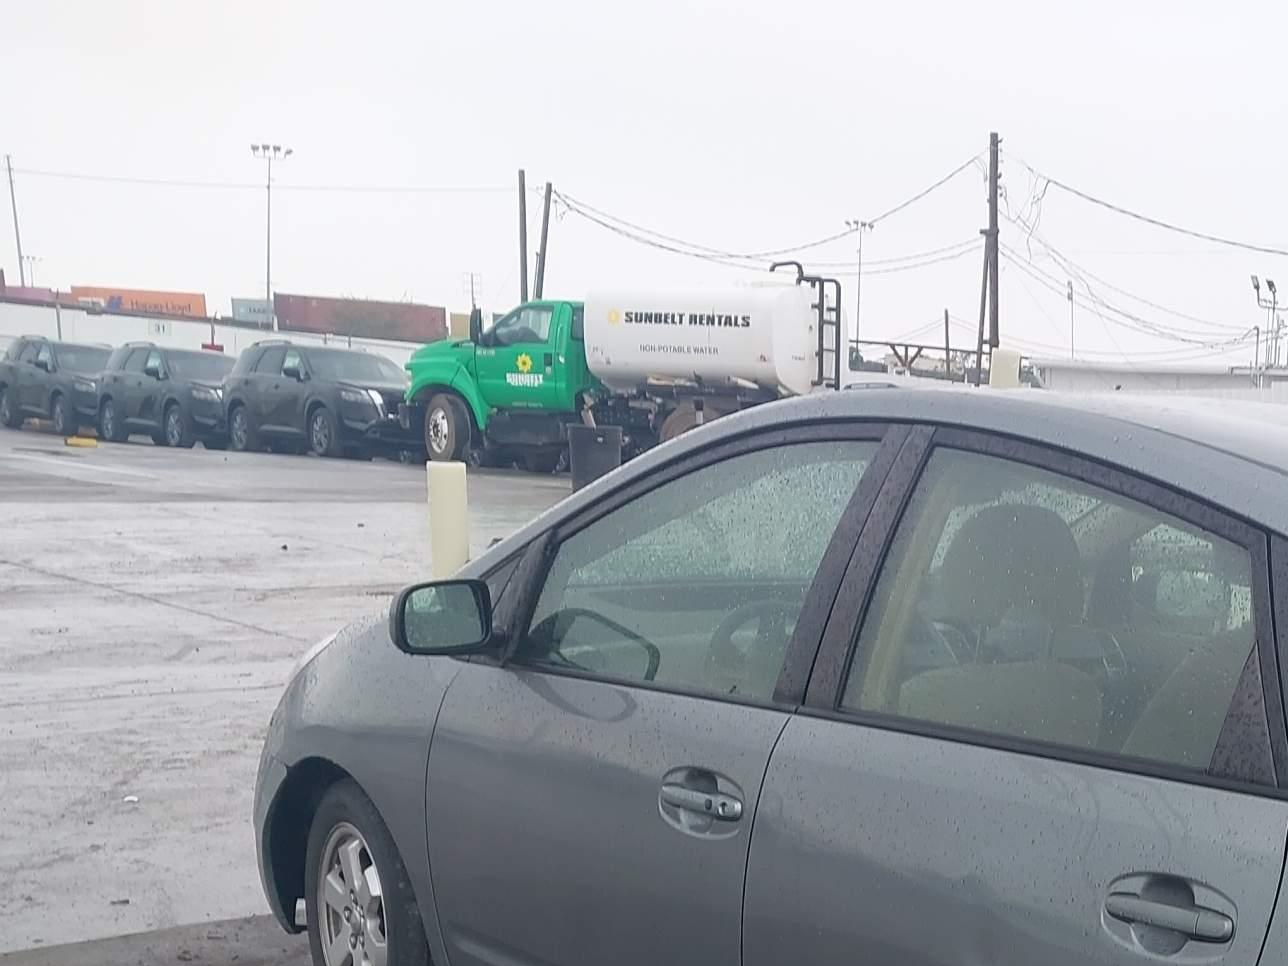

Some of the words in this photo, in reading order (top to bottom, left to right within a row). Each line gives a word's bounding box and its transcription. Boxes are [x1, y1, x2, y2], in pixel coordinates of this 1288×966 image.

[624, 311, 685, 325] SUNBELT
[688, 313, 751, 328] RENTALS
[639, 344, 692, 354] NON-POTABLE
[693, 345, 719, 355] WATER
